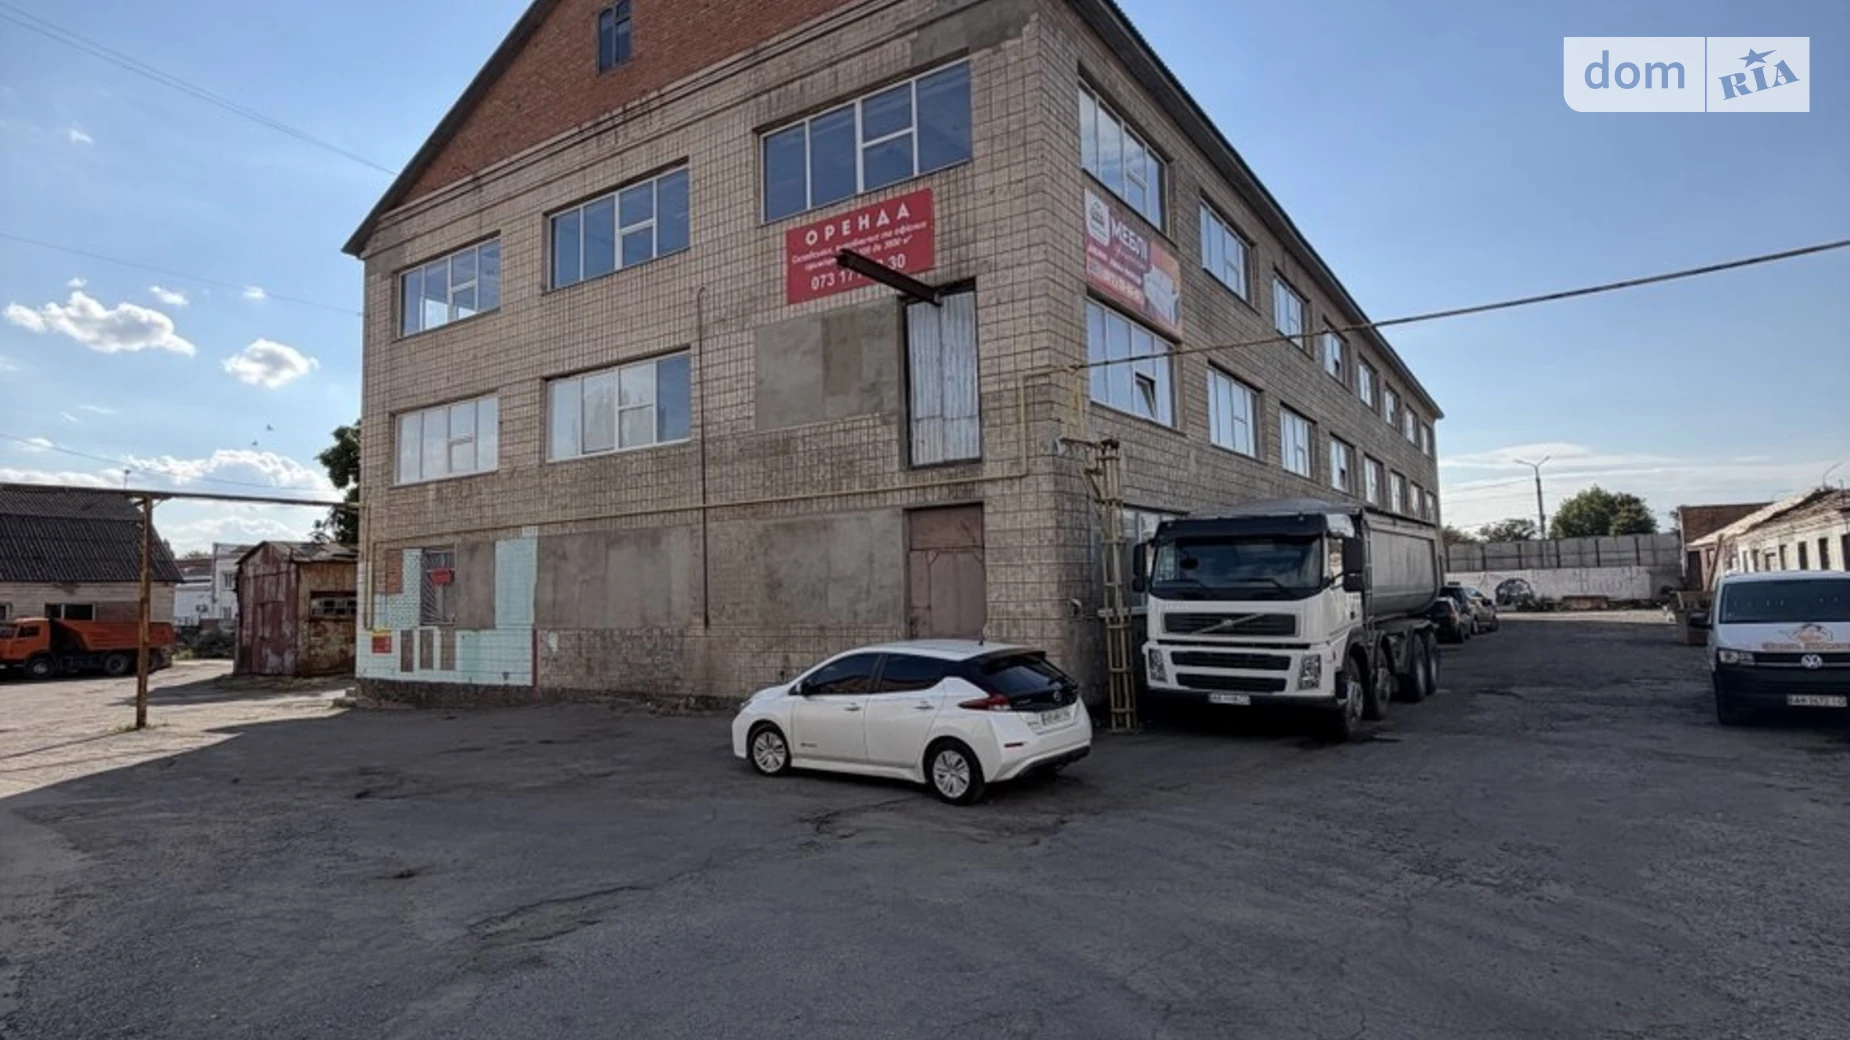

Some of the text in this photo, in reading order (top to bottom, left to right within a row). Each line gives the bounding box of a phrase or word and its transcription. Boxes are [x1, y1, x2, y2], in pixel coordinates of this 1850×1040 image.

[805, 201, 910, 246] ОРЕНДА
[811, 272, 836, 290] 073
[888, 253, 906, 270] 30
